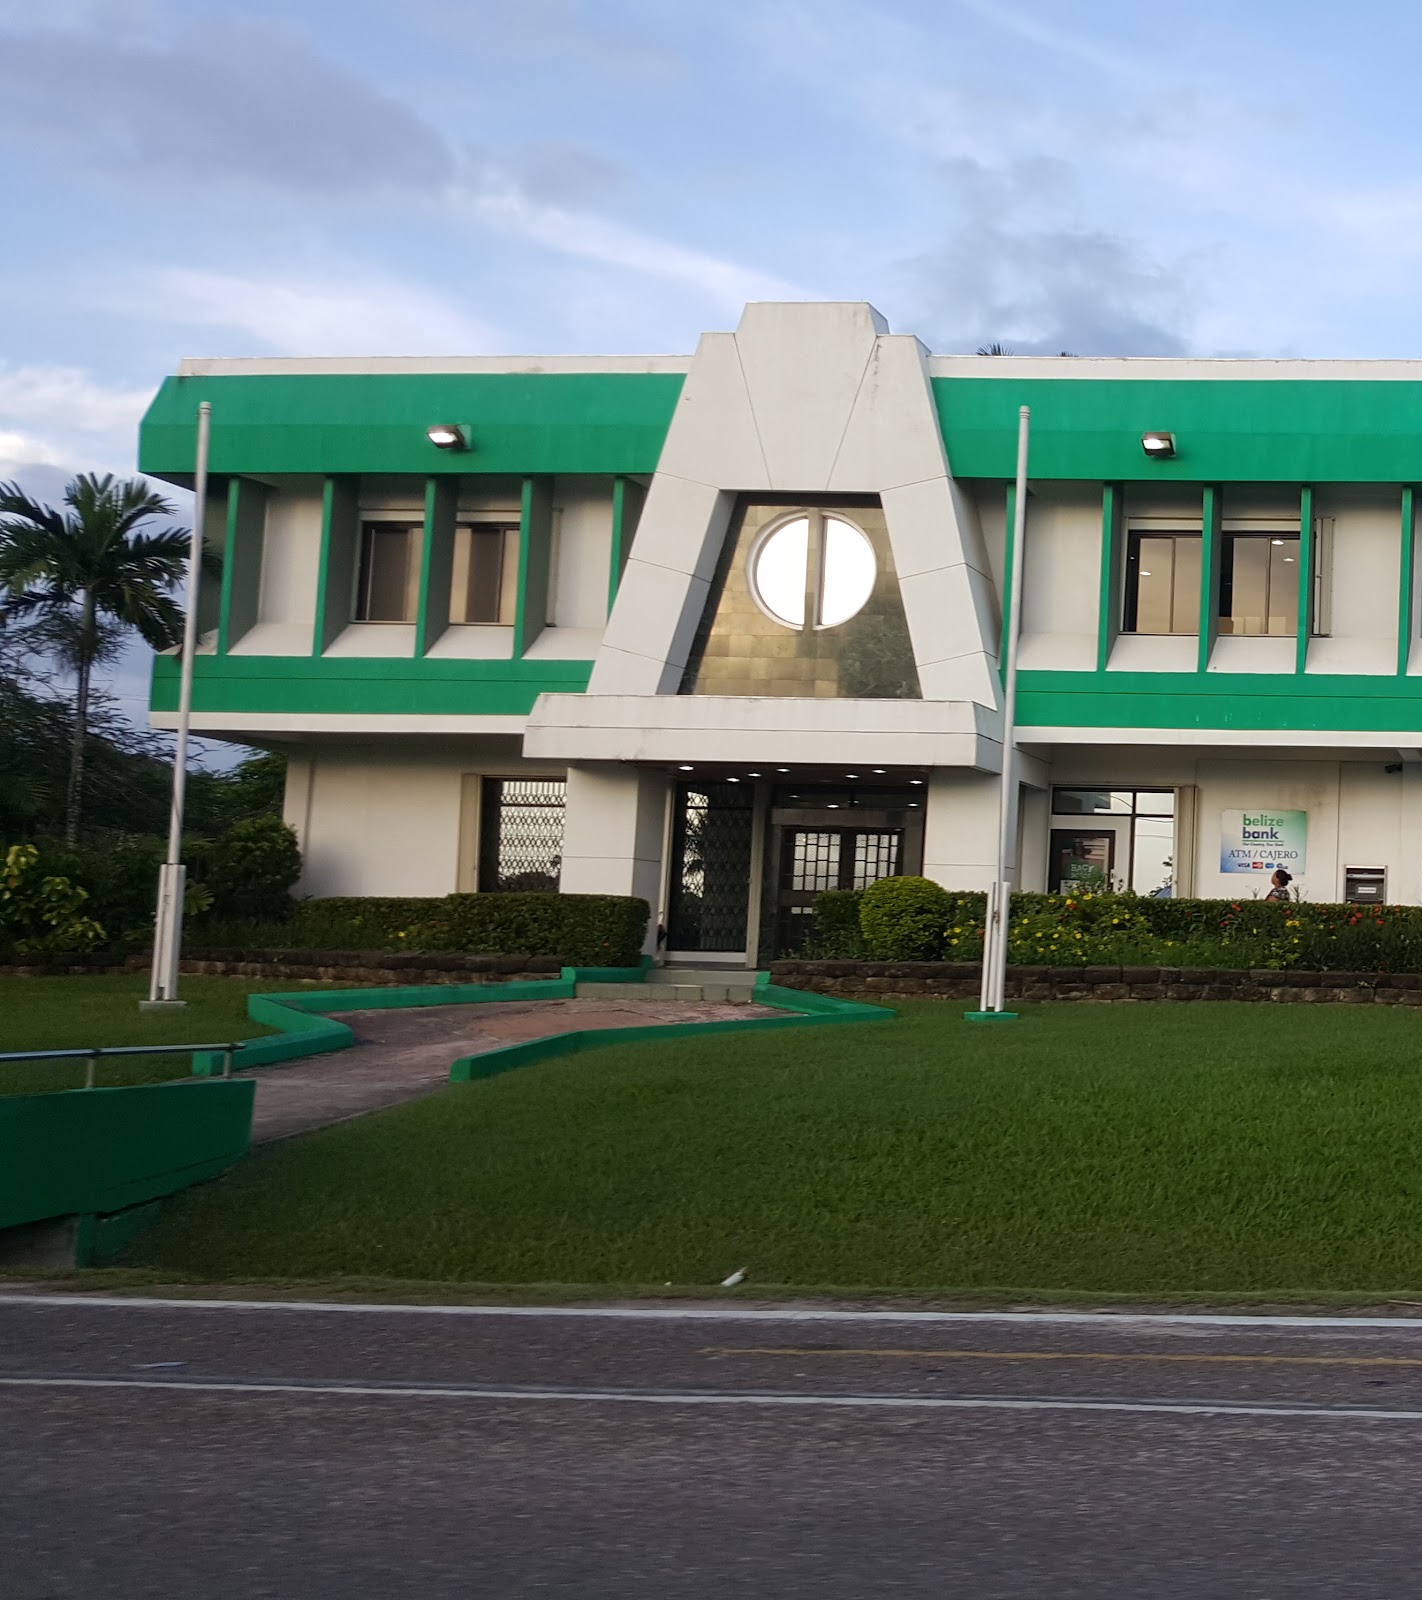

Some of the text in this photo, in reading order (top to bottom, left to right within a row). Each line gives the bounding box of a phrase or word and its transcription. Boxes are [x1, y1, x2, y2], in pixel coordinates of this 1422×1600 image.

[1243, 814, 1284, 826] belize
[1242, 827, 1279, 839] bank
[1228, 850, 1298, 860] ATM / CAJERO
